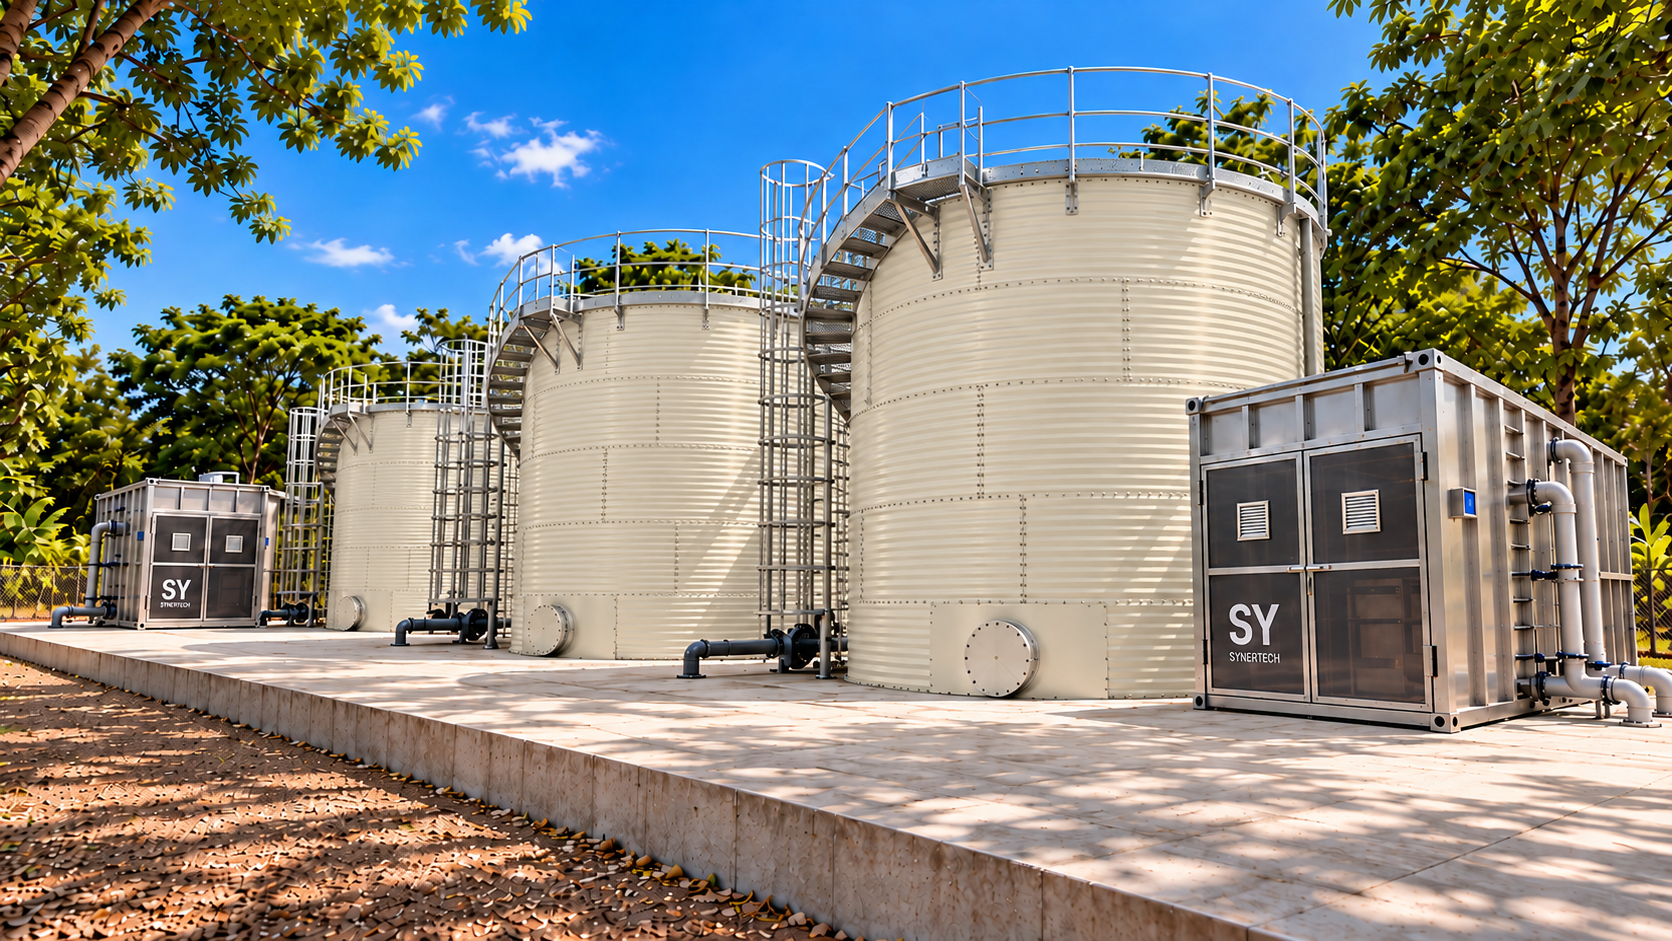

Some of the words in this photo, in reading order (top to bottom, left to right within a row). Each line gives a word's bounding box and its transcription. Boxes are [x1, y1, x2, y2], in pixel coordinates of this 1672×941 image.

[161, 579, 191, 600] SY
[1229, 604, 1280, 645] SY
[1229, 652, 1280, 664] SYNERTECH
